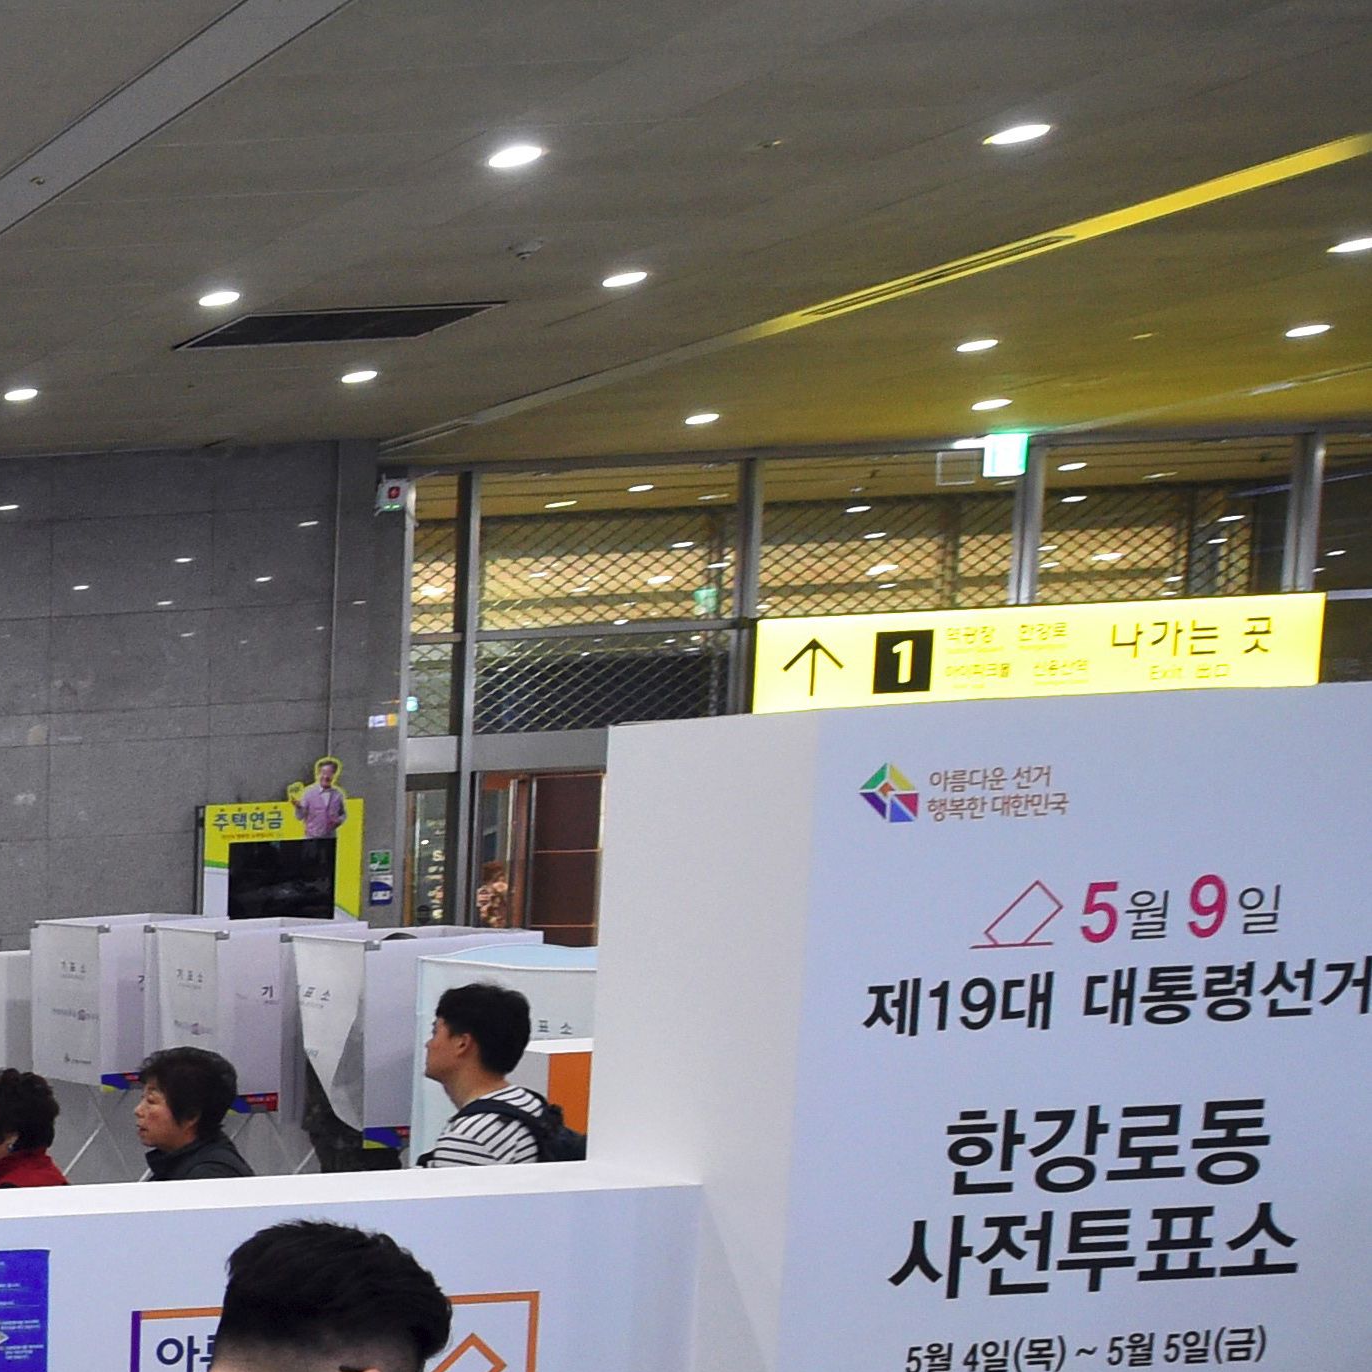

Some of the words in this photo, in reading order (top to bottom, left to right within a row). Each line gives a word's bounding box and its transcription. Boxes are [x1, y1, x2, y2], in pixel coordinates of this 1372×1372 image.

[1111, 619, 1219, 659] 나가는
[1244, 616, 1272, 654] 곳
[891, 639, 915, 685] 1
[929, 767, 1008, 793] 아름다운
[1011, 764, 1052, 789] 선거
[213, 810, 283, 831] 주택연금
[927, 796, 988, 824] 행복한
[991, 791, 1069, 818] 대한민국
[1080, 881, 1169, 944] 5월
[1187, 873, 1282, 939] 9일
[862, 970, 1055, 1036] 제19대
[1082, 955, 1372, 1028] 대통령선거
[538, 1020, 574, 1036] 표소
[945, 1099, 1272, 1196] 한강로동
[888, 1202, 1299, 1300] 사전투표소
[1106, 1333, 1156, 1369] 5월
[1163, 1325, 1267, 1366] 5일(금)
